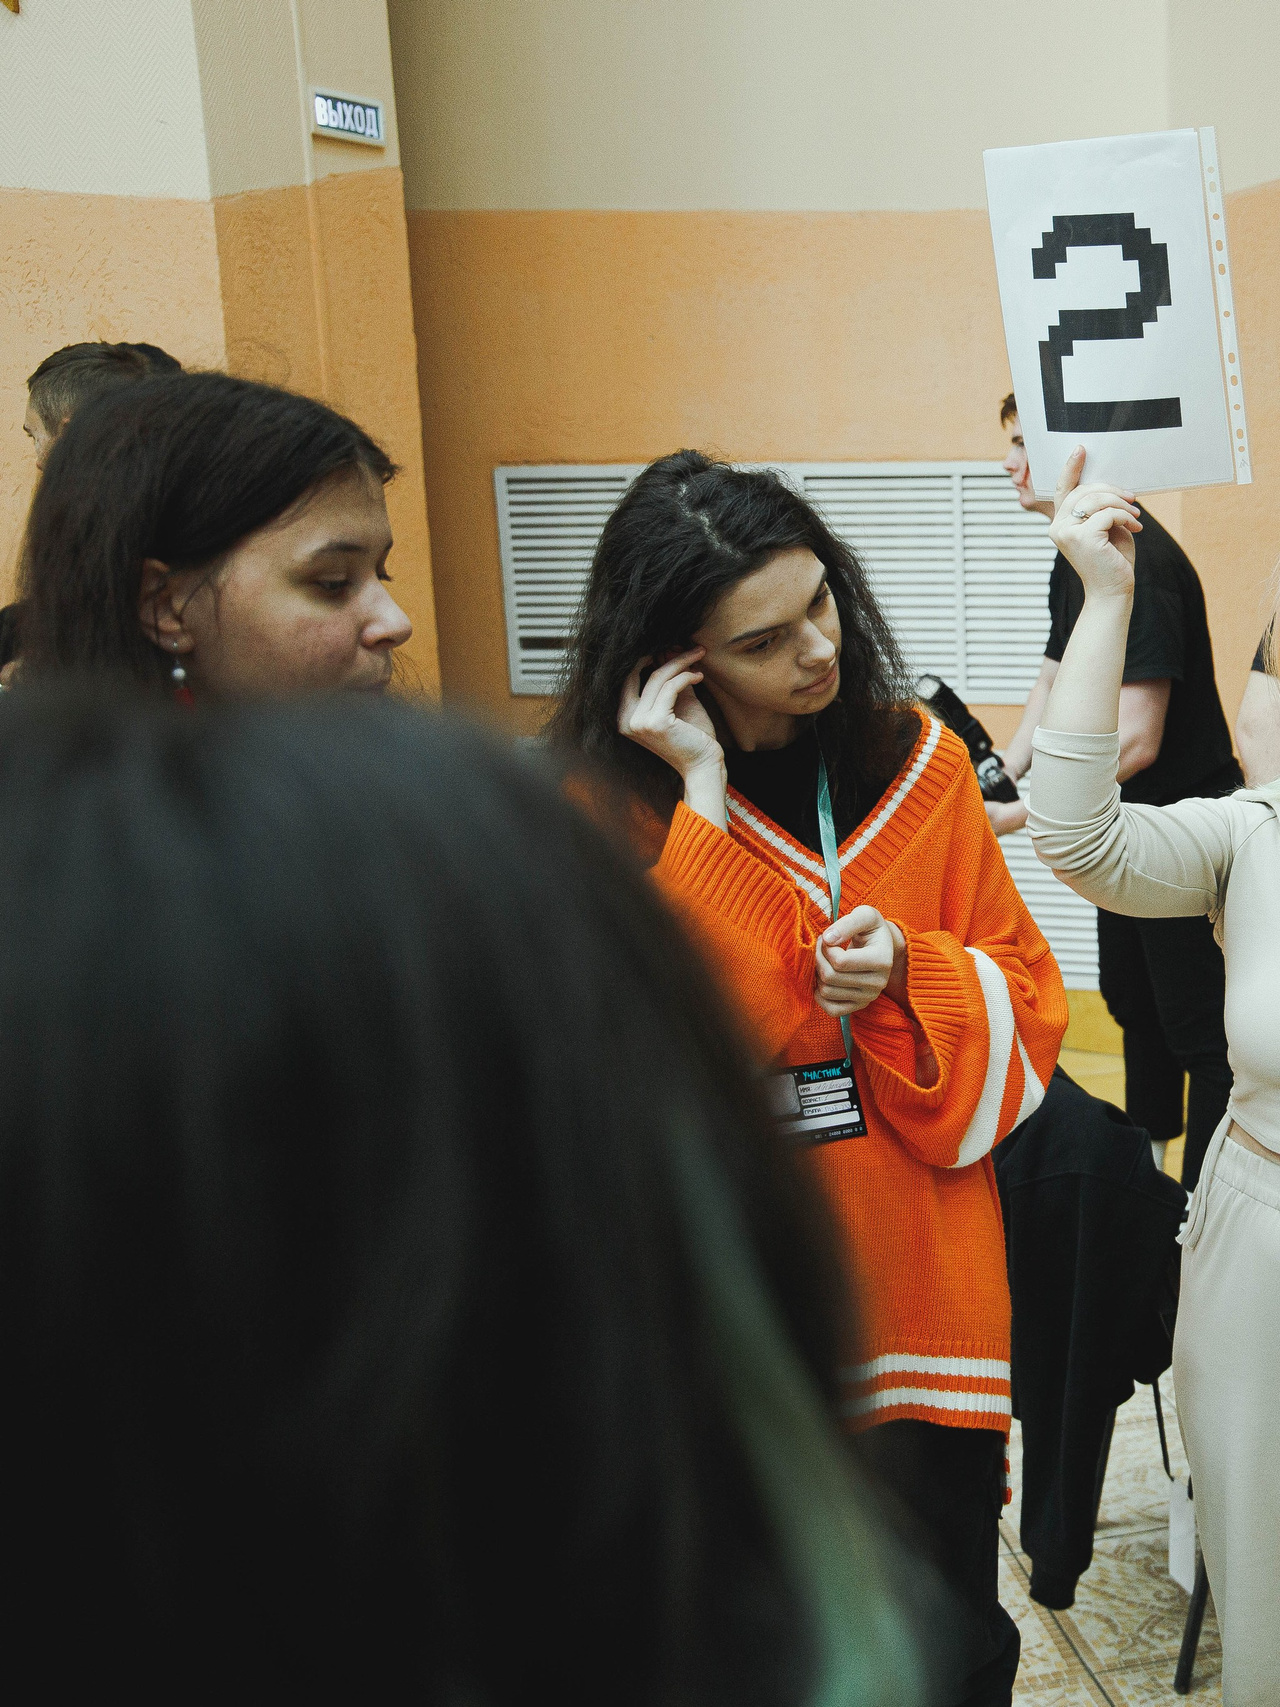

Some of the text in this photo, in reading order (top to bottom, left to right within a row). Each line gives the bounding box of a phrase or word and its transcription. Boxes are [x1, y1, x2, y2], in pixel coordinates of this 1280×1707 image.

[315, 96, 380, 139] ВЫХОД
[1031, 212, 1183, 433] 2
[803, 1067, 842, 1081] УЧАСТНИК
